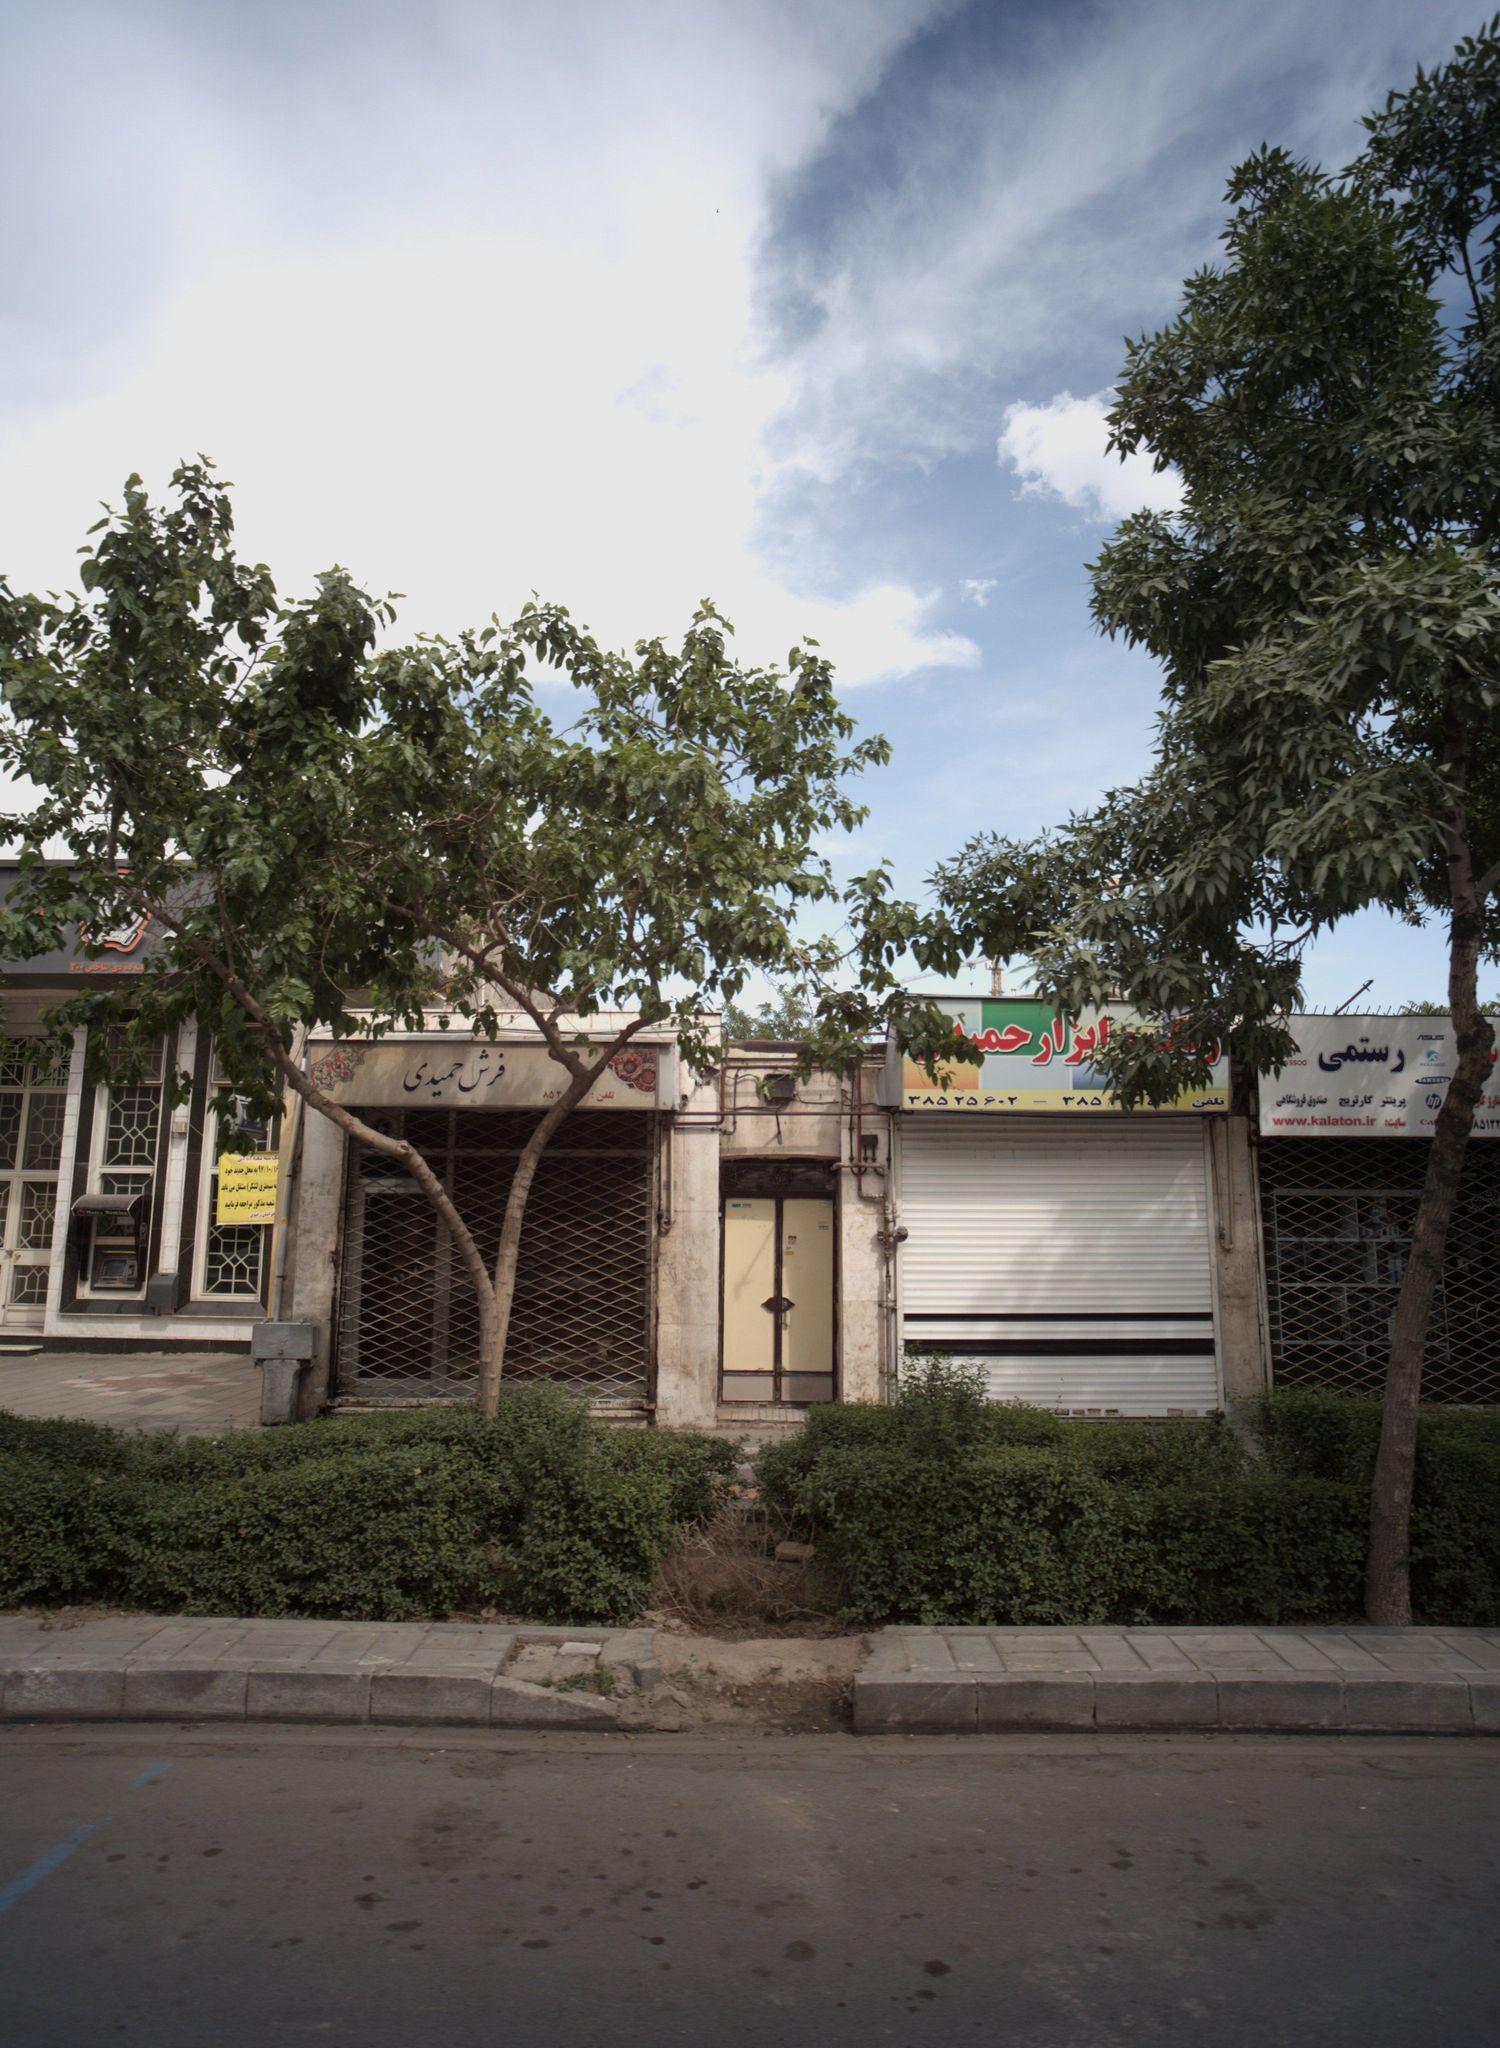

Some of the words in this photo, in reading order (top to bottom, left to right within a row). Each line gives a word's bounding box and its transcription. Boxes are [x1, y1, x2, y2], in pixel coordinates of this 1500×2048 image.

[908, 1022, 1032, 1064] حمی
[1031, 1012, 1109, 1065] ابزار
[1318, 1037, 1405, 1073] رستمی
[403, 1061, 463, 1098] حمیدی
[458, 1048, 505, 1092] فرش
[1192, 1097, 1225, 1108] تلفن
[1380, 1096, 1406, 1109] پرینتر
[1272, 1115, 1376, 1127] www.kalaton.ir
